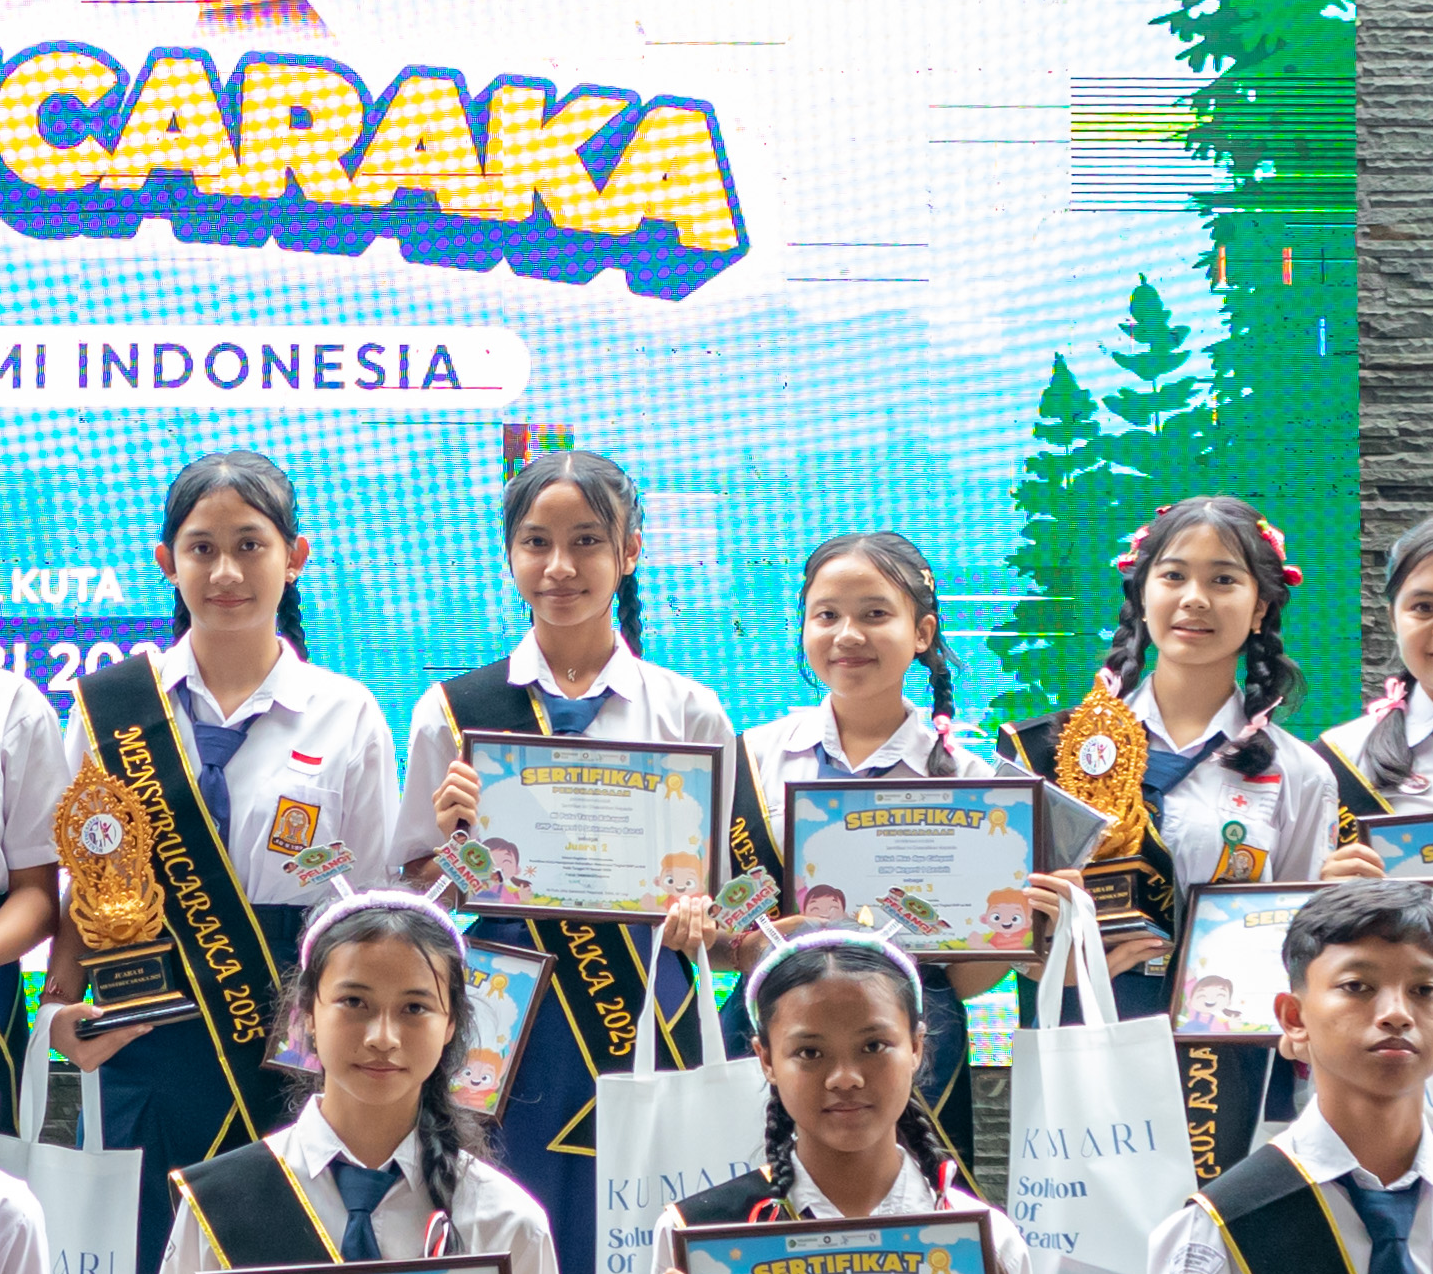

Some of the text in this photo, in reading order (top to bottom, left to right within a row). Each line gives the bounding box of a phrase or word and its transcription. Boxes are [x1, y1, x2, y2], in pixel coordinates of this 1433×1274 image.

[75, 340, 463, 390] INDONESIA
[11, 569, 123, 604] KUTA
[520, 767, 664, 792] SERTIFIKAT
[845, 807, 985, 830] SERTIFIKAT
[440, 845, 483, 894] PELANGI
[224, 985, 265, 1044] 2025
[1015, 1201, 1042, 1221] Of
[608, 1253, 634, 1274] Of
